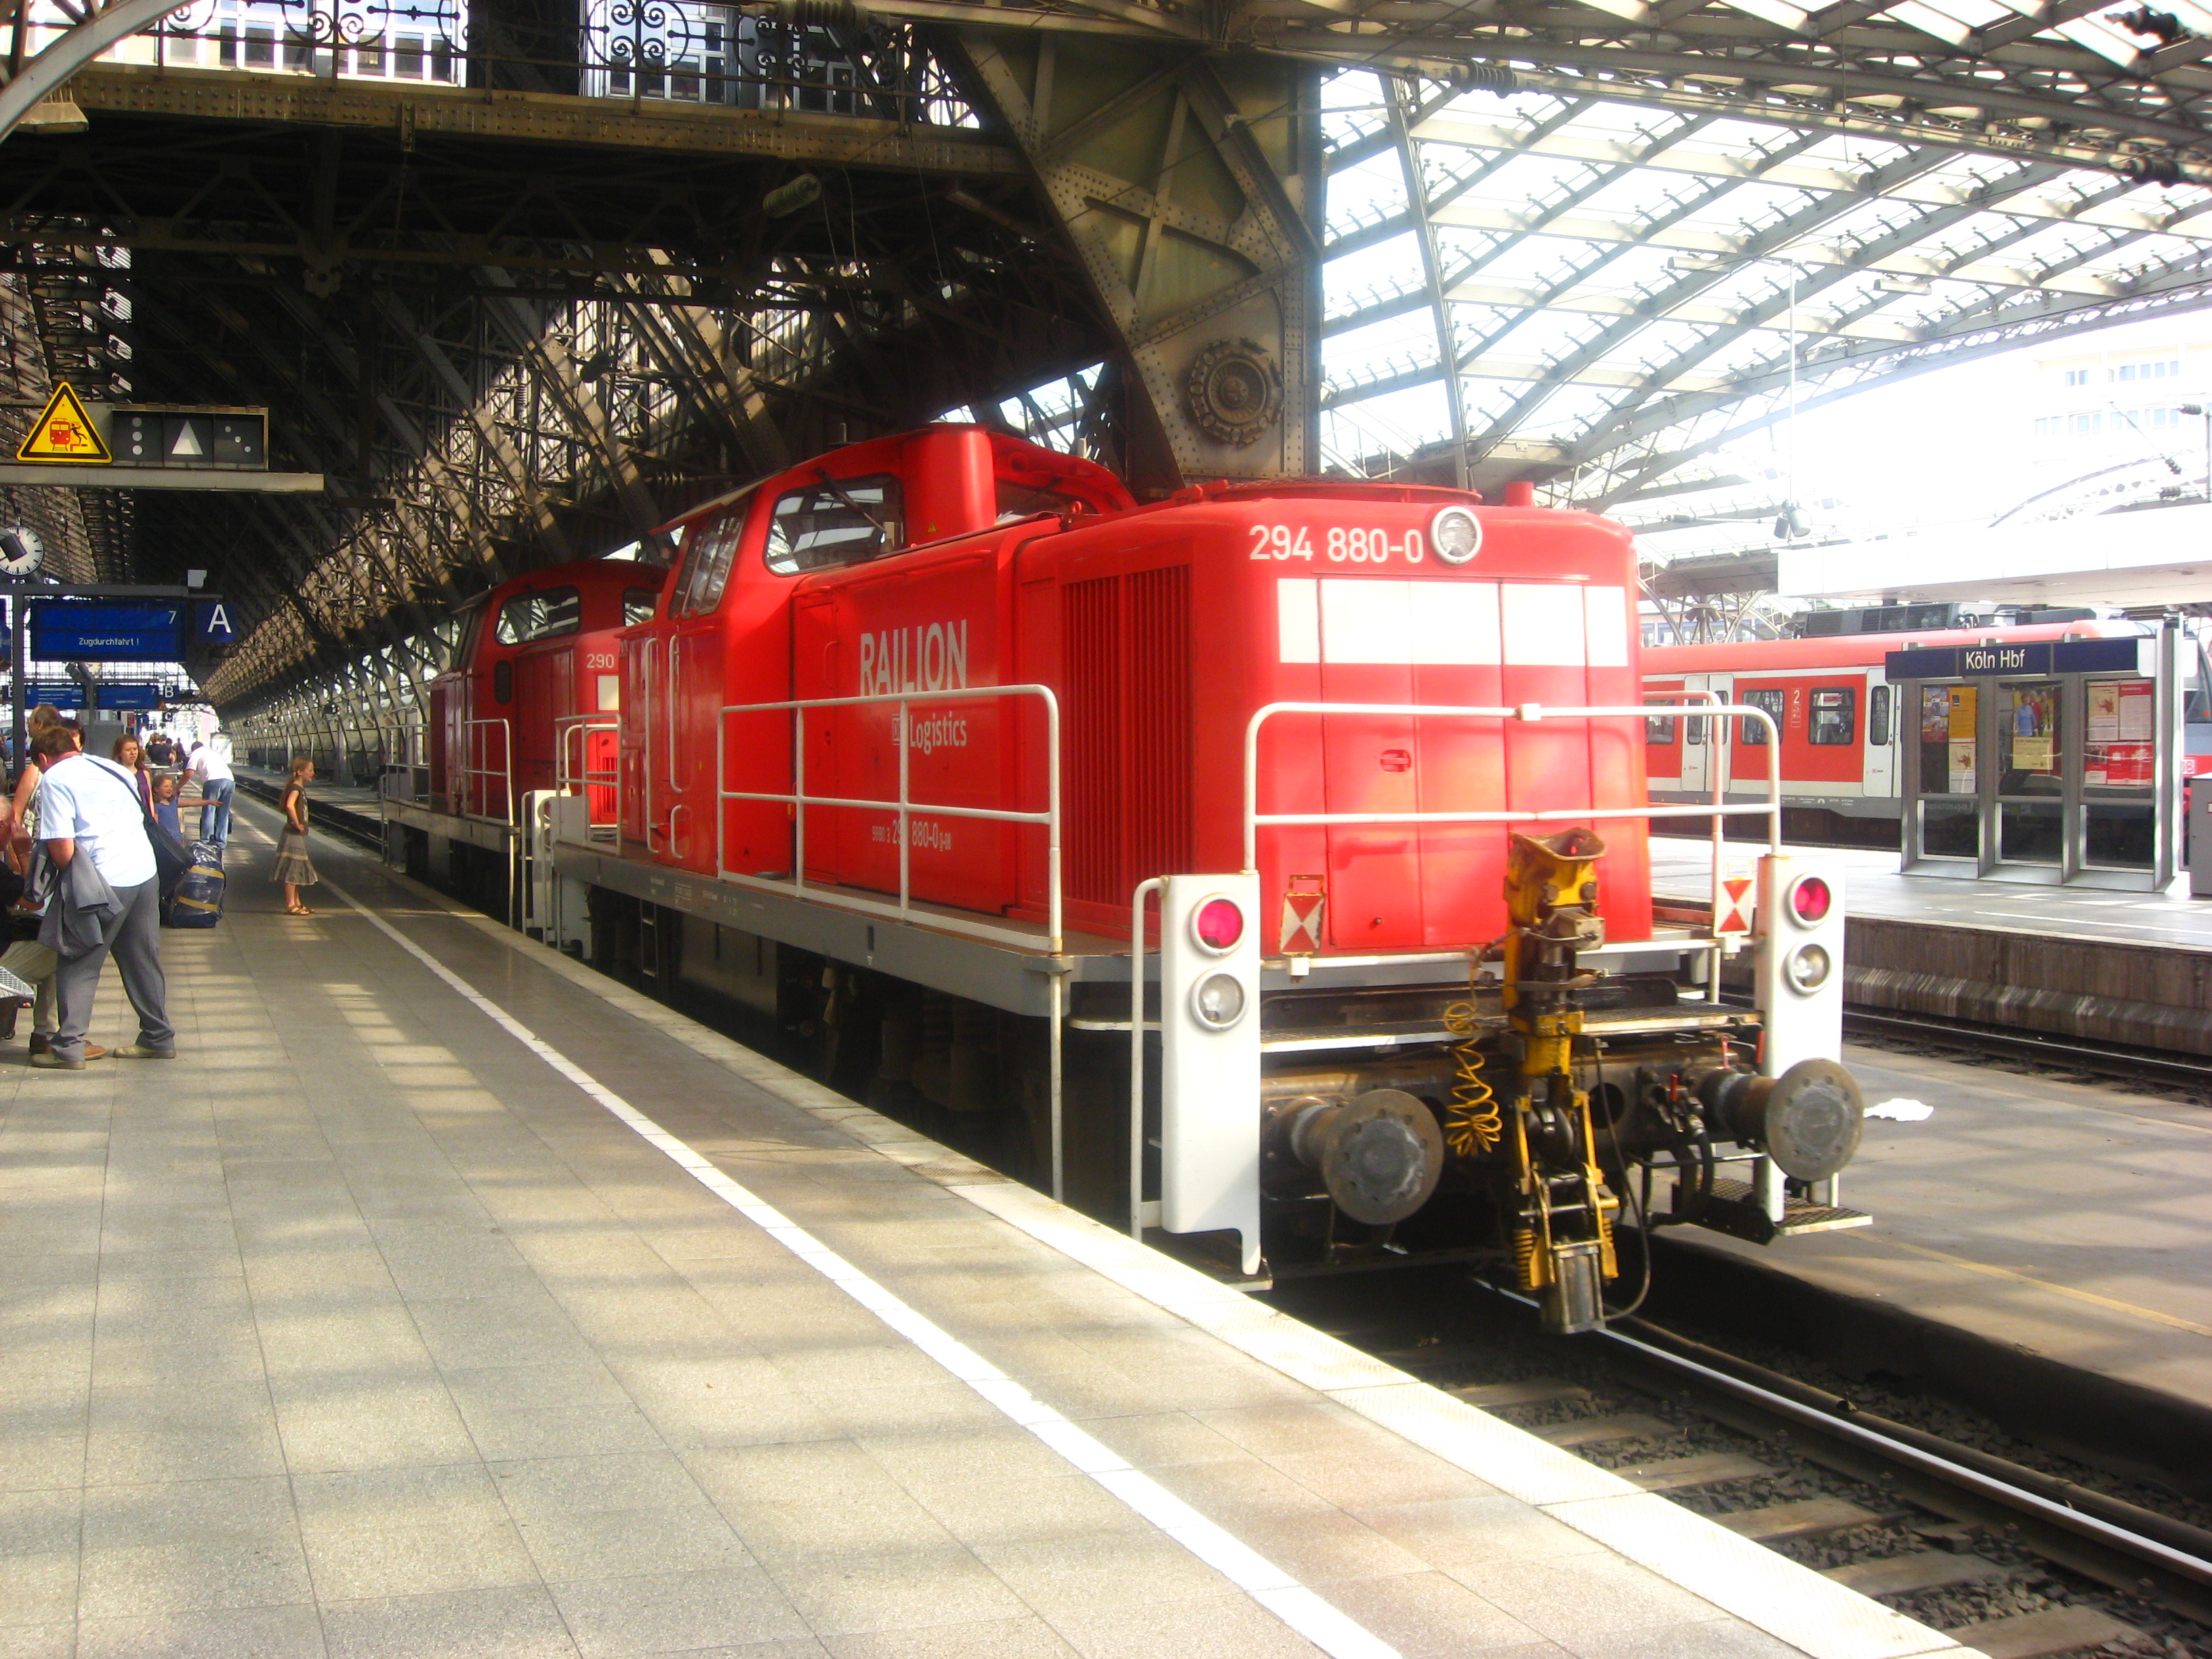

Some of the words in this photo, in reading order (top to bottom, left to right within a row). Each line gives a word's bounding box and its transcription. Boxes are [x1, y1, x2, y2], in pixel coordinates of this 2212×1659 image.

[1249, 525, 1313, 561] 294
[1326, 527, 1424, 564] 880-0
[168, 610, 177, 625] 7
[207, 604, 232, 634] A
[79, 637, 134, 647] Zugdurchfahrt
[586, 653, 615, 669] 290
[860, 619, 967, 697] RAILION
[1965, 651, 1995, 670] Köln
[2000, 649, 2026, 668] Hbf
[165, 686, 174, 698] B
[1793, 689, 1801, 704] 2
[165, 712, 172, 721] C
[909, 710, 967, 755] Logistics
[912, 820, 939, 849] 880-0
